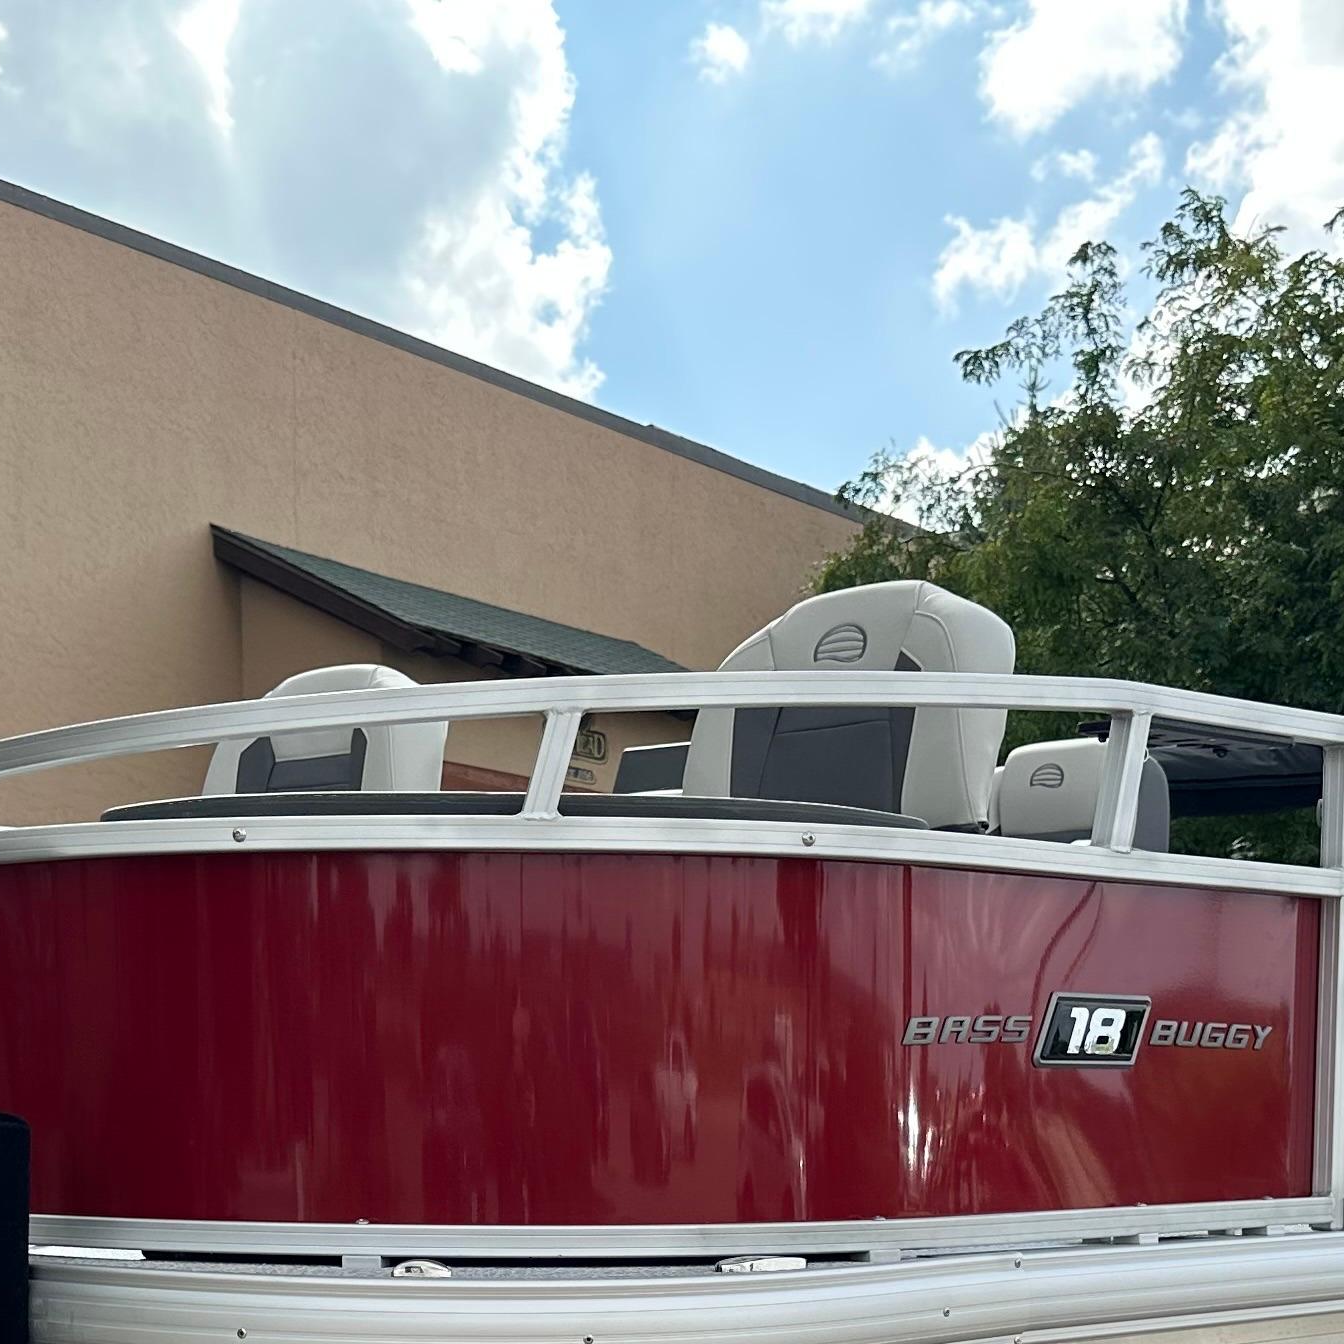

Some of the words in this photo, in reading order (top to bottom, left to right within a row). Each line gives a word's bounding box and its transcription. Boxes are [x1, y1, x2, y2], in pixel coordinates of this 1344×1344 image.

[902, 1014, 1033, 1046] BASS
[1066, 1007, 1127, 1055] 18
[1150, 1019, 1273, 1051] BUGGY
